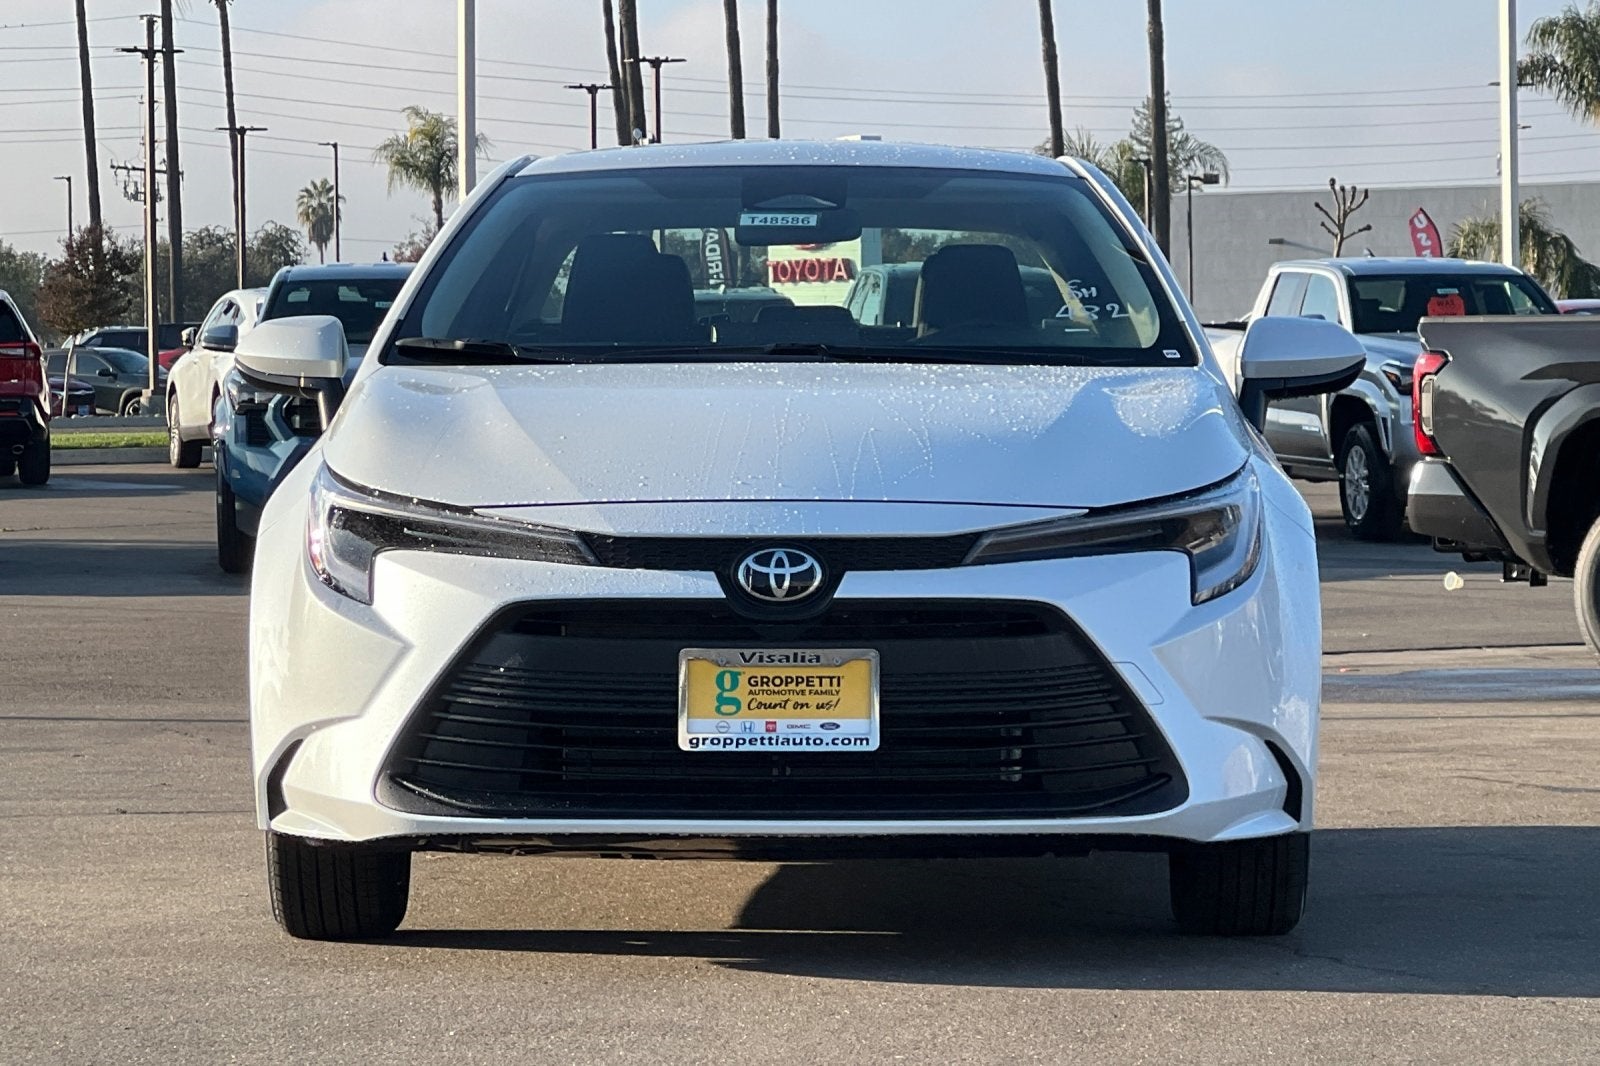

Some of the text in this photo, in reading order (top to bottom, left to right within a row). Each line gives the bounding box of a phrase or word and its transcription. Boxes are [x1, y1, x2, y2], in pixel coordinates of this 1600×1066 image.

[749, 216, 811, 225] T48586
[767, 259, 847, 281] TOYOTA
[739, 652, 821, 663] Visalia
[747, 675, 841, 687] GROPPETTI
[747, 697, 841, 711] Count on us!
[689, 735, 870, 748] groppettiauto.com
